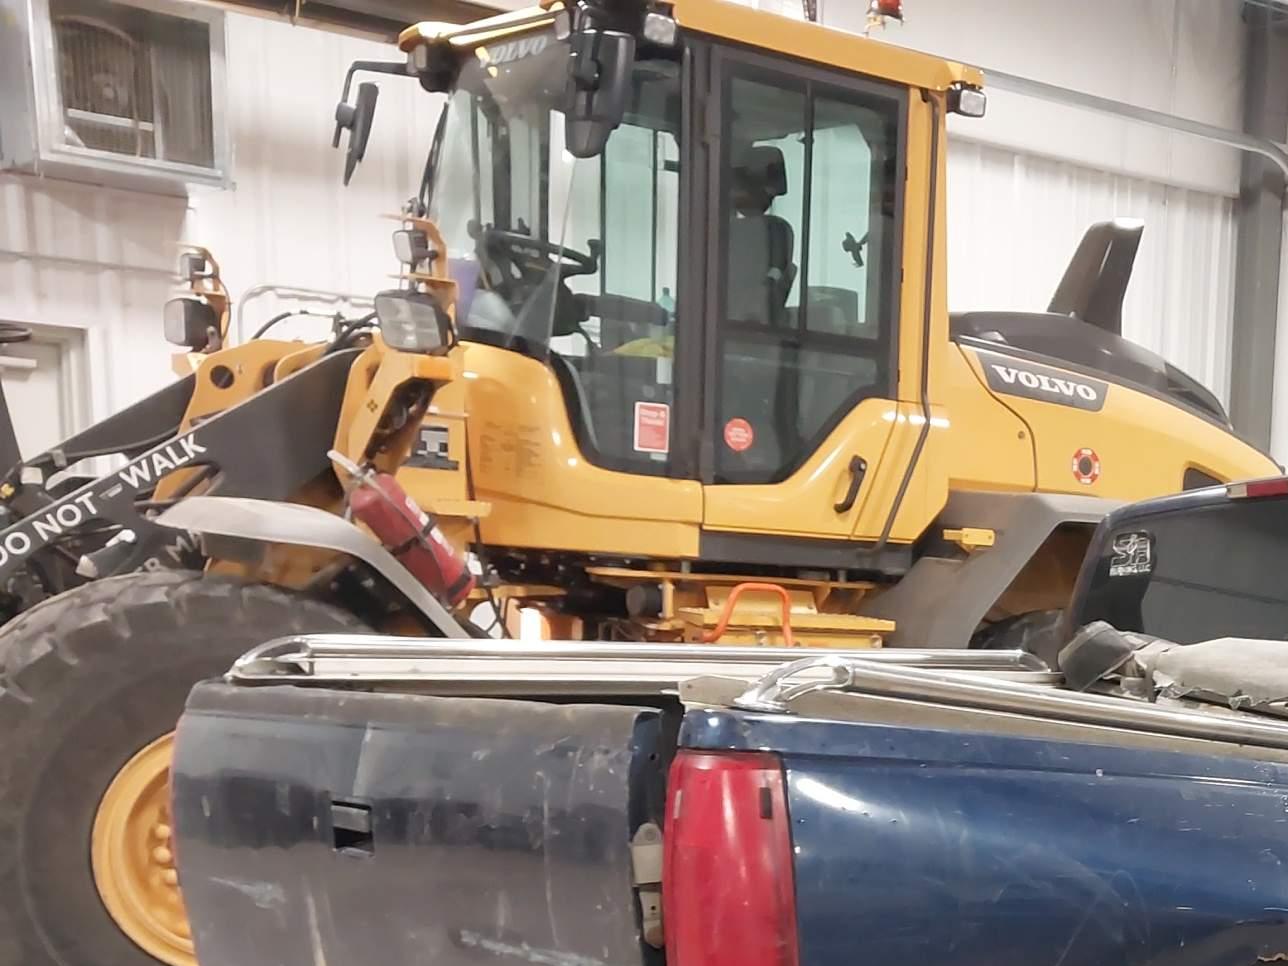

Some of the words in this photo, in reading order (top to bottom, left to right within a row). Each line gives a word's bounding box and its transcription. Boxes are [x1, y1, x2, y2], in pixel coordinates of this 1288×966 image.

[477, 36, 548, 68] OLVO
[991, 364, 1097, 401] VOLVO
[32, 491, 97, 541] NOT
[119, 433, 207, 489] WALK
